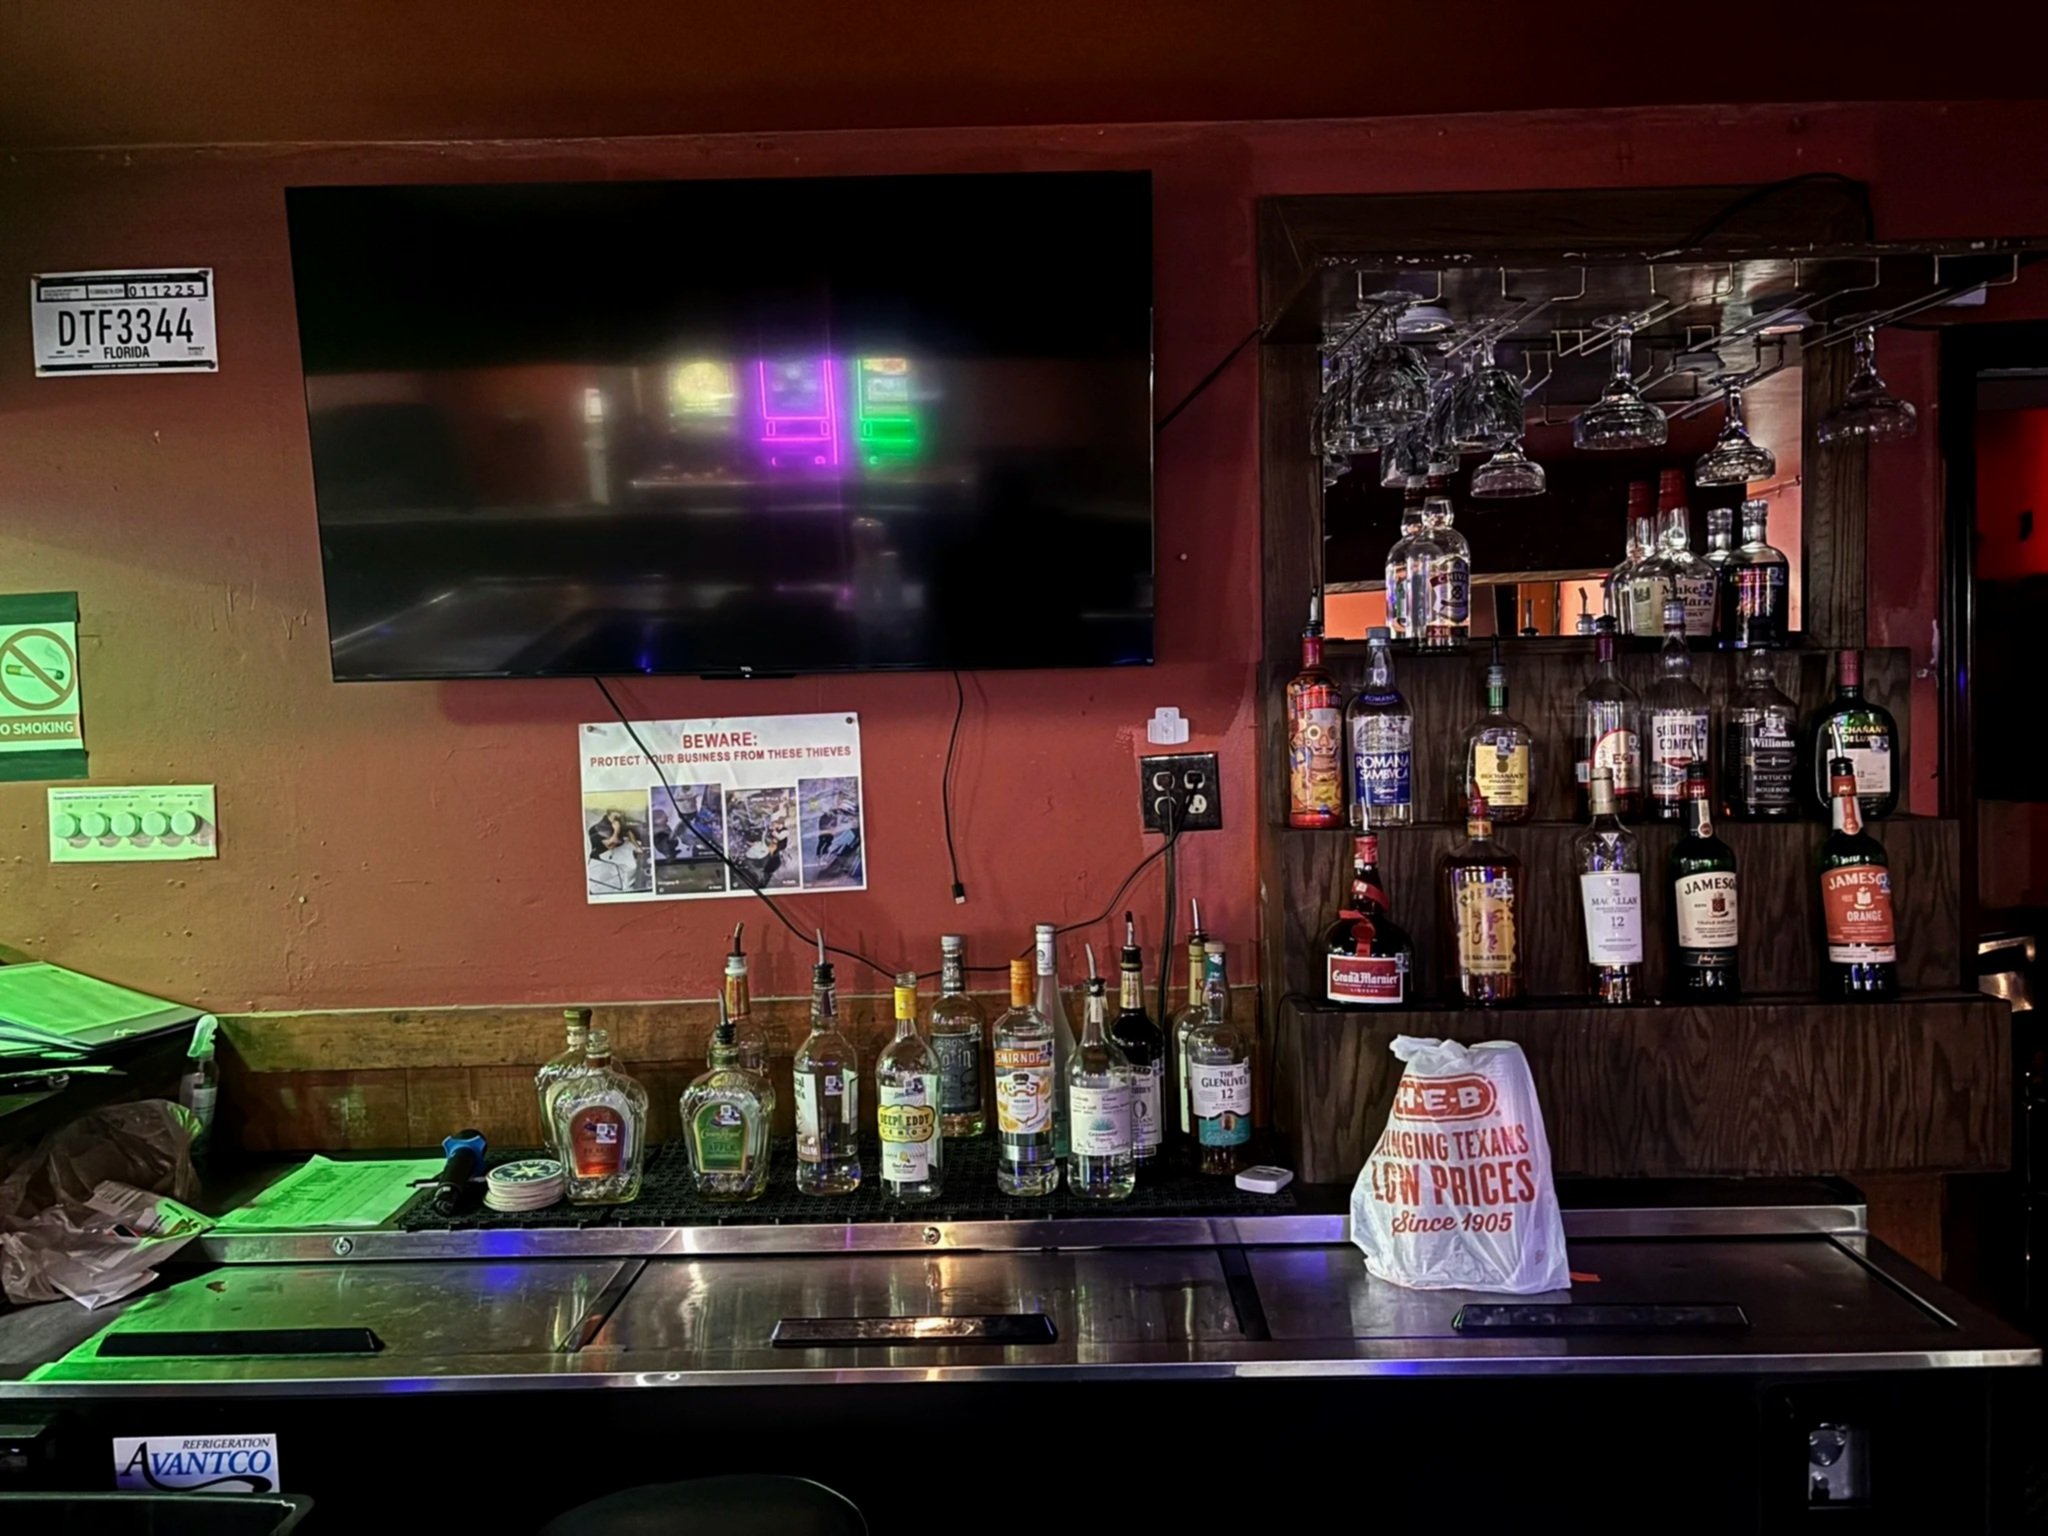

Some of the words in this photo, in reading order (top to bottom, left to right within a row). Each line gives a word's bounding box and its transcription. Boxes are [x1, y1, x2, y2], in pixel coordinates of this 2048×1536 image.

[129, 284, 195, 298] 011225
[58, 307, 193, 347] DTF3344
[103, 346, 150, 359] FLORIDA
[0, 723, 10, 735] O
[13, 721, 74, 735] SMOKING
[682, 731, 758, 750] BEWARE:
[1750, 738, 1795, 748] Williams
[590, 755, 640, 768] PROTECT
[644, 753, 674, 765] YOUR
[677, 751, 731, 764] BUSINESS
[734, 749, 764, 761] FROM
[768, 748, 803, 759] THESE
[806, 746, 851, 758] THIEVES
[1355, 755, 1409, 769] ROMANA
[1684, 877, 1736, 895] JAMESO
[1828, 872, 1886, 890] JAMESO
[1611, 916, 1625, 928] 12
[1846, 911, 1883, 923] ORANGE
[995, 1051, 1041, 1064] SMIRNOF
[1219, 1070, 1234, 1078] THE
[1220, 1088, 1234, 1100] 12
[906, 1113, 930, 1126] EDDY
[1452, 1123, 1529, 1161] TEXANS
[1371, 1160, 1421, 1206] LOW
[1429, 1158, 1536, 1207] PRICES
[1391, 1209, 1457, 1235] Since
[1461, 1211, 1514, 1233] 1905
[182, 1437, 271, 1450] REFRIGERATION
[119, 1441, 272, 1480] AVANTCO
